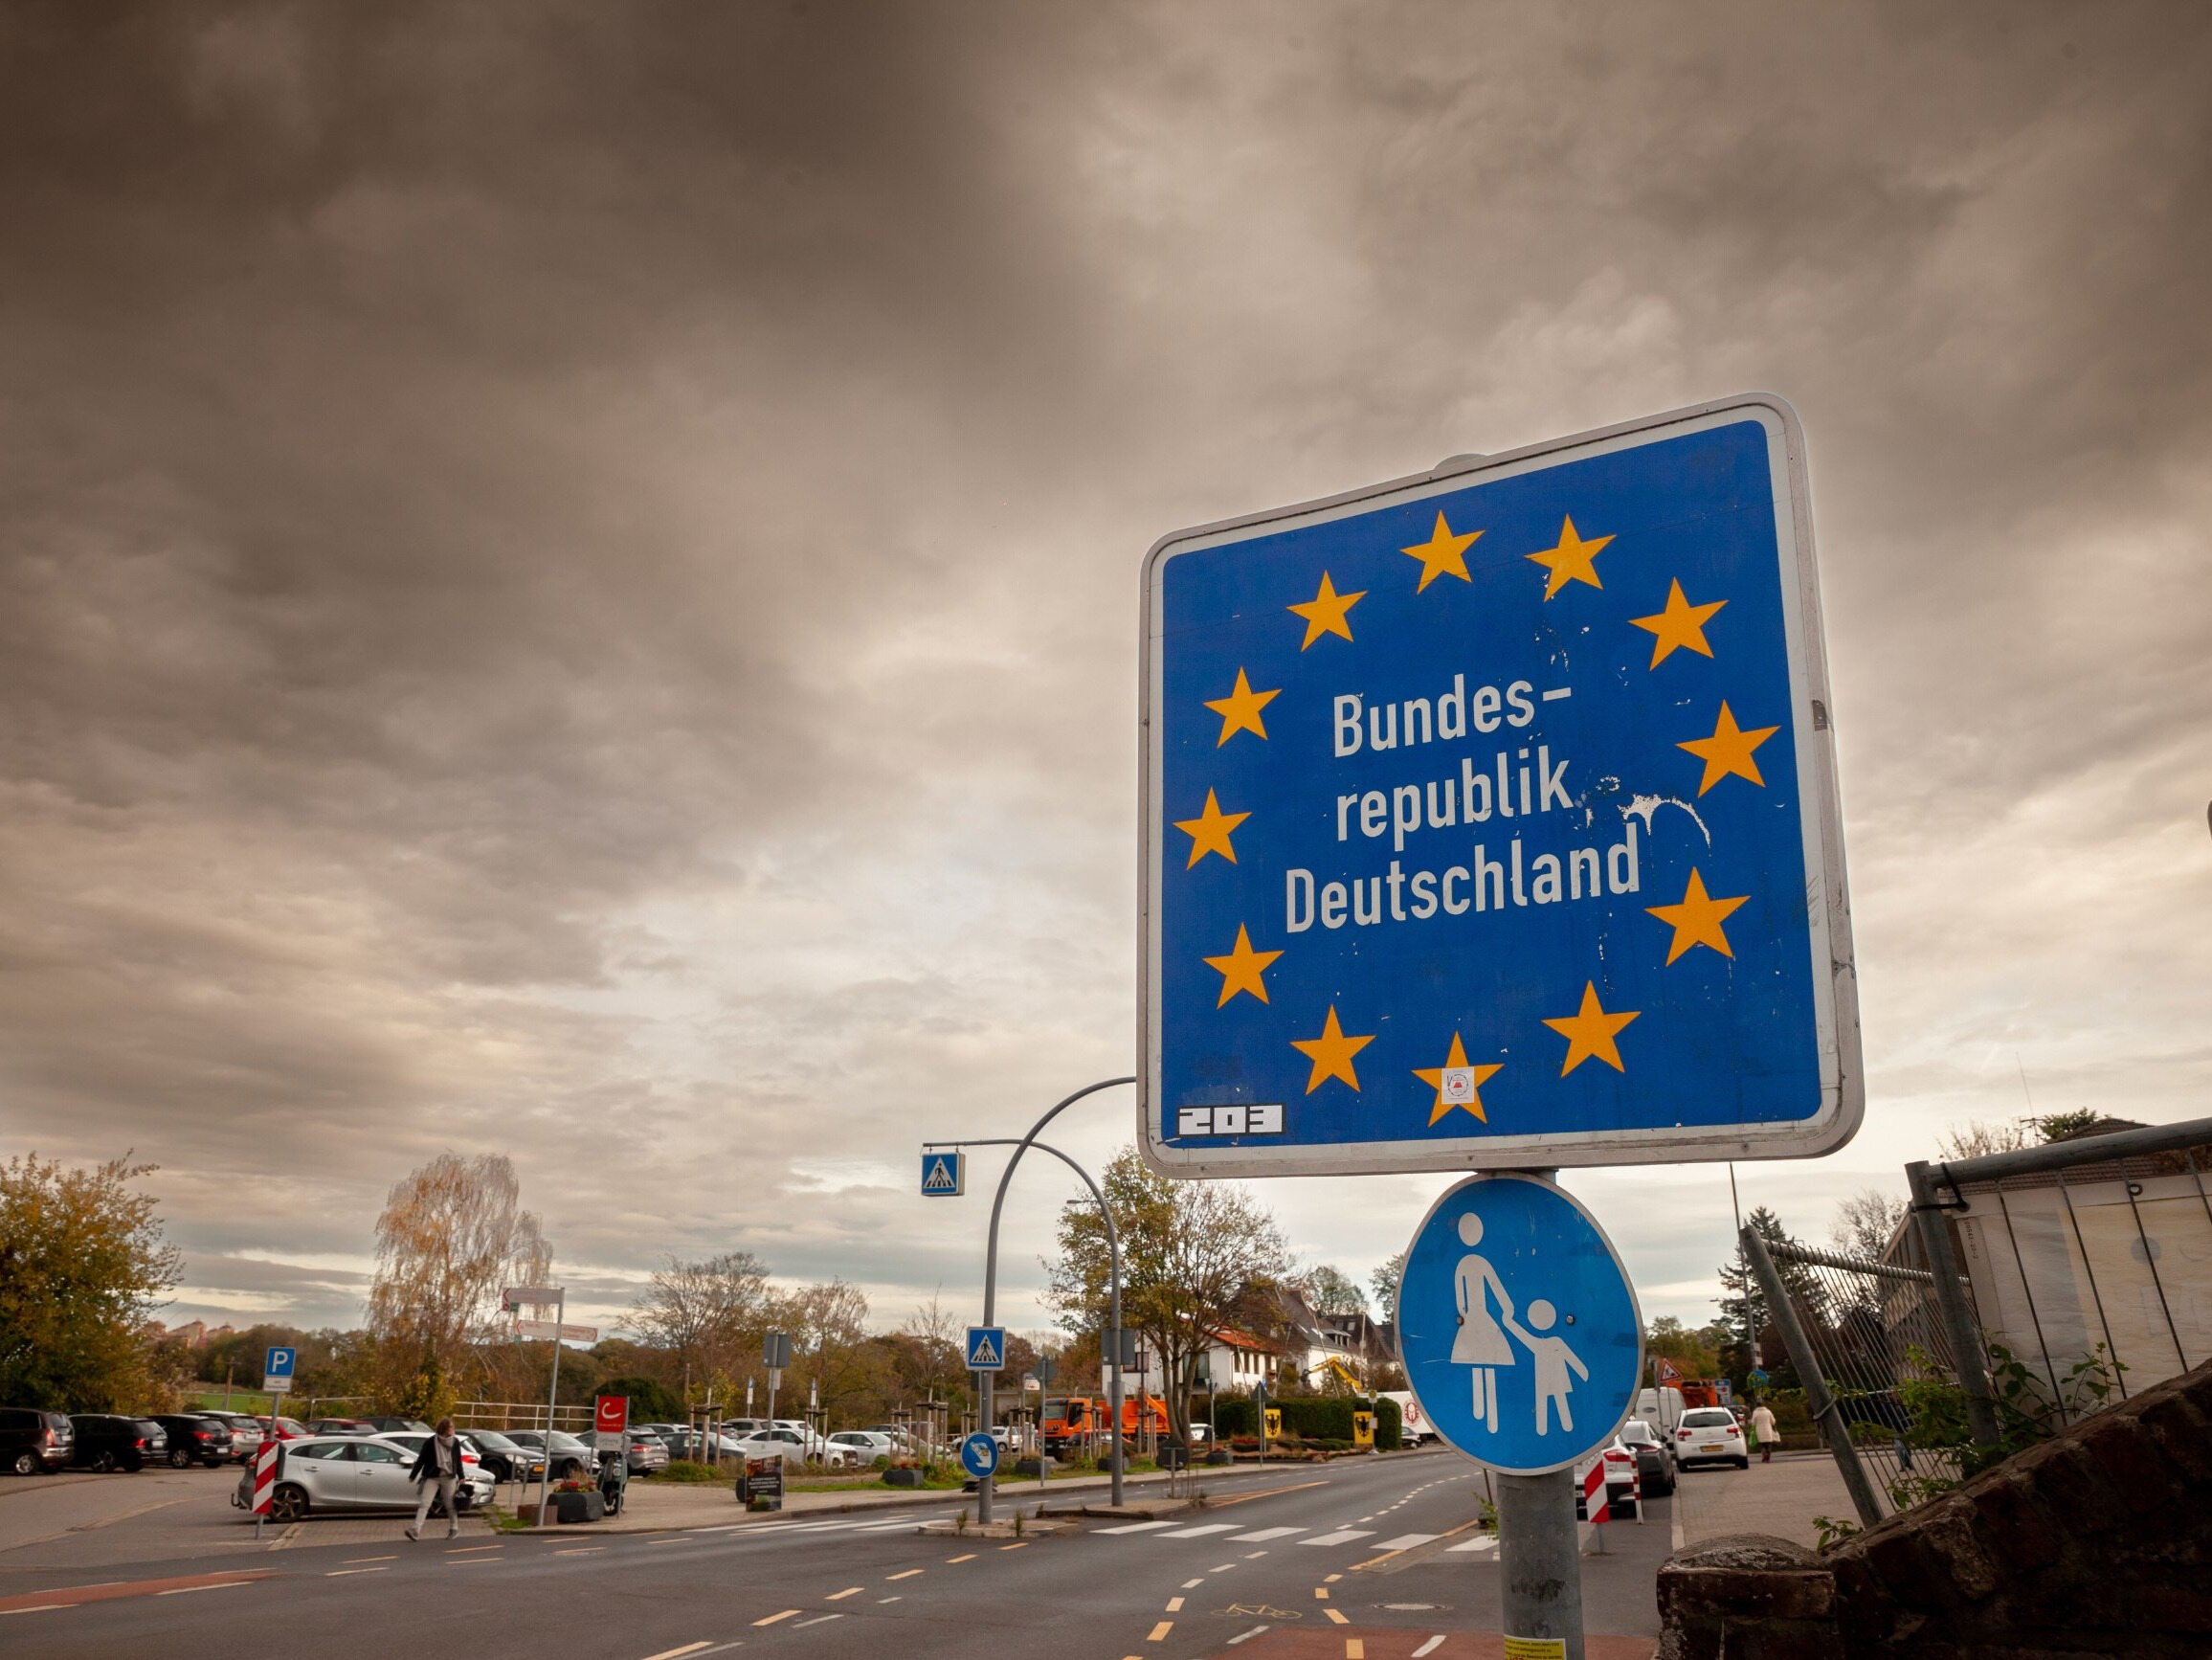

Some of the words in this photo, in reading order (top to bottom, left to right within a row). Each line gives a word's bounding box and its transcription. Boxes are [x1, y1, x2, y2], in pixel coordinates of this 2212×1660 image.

[1333, 673, 1573, 758] Bundes-
[1336, 745, 1575, 852] republik
[1285, 821, 1640, 933] Deutschland
[1178, 1104, 1284, 1135] 203
[271, 1350, 289, 1374] P
